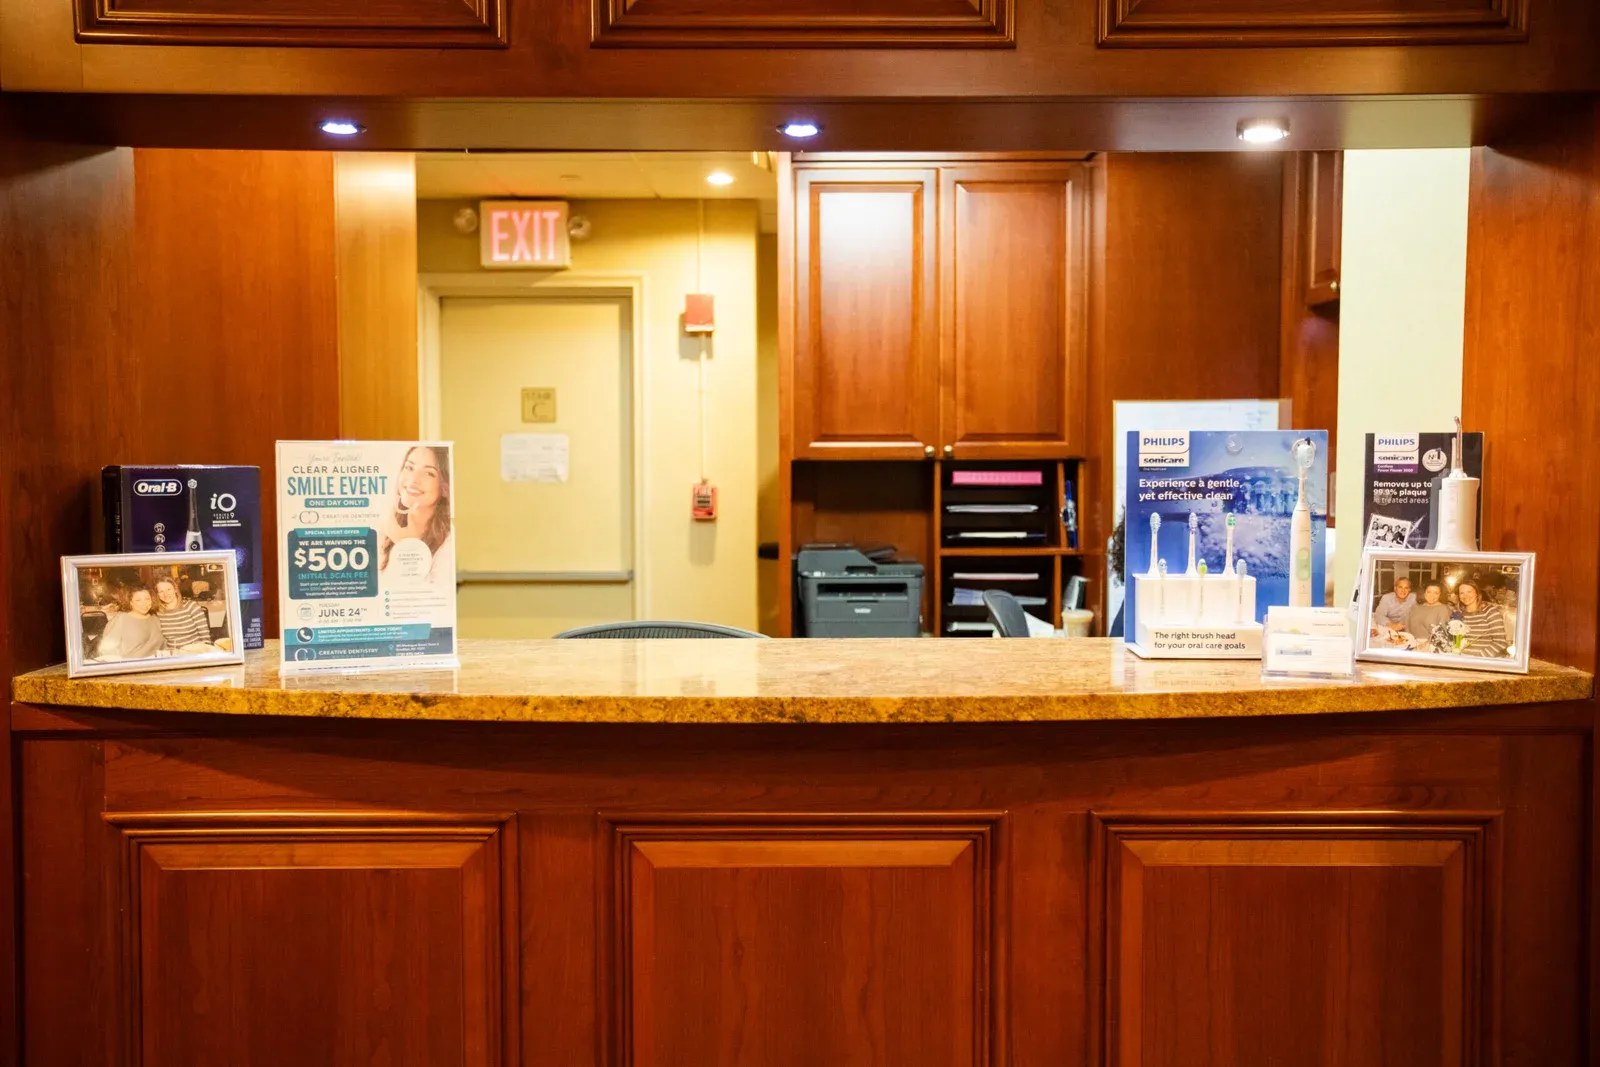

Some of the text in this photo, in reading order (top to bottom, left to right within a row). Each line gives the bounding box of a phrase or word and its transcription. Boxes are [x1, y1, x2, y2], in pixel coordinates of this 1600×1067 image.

[491, 210, 560, 262] EXIT
[1144, 438, 1184, 446] PHILIPS
[292, 465, 380, 474] CLEAR ALIGNER
[138, 482, 177, 493] Oral-B
[287, 476, 388, 495] SMILE EVENT
[1139, 478, 1196, 489] Experience
[1207, 478, 1243, 489] gentle,
[1139, 491, 1233, 502] yet effective clean
[210, 493, 236, 512] iO
[294, 547, 370, 571] $500
[318, 608, 345, 617] JUNE
[1171, 632, 1189, 640] right
